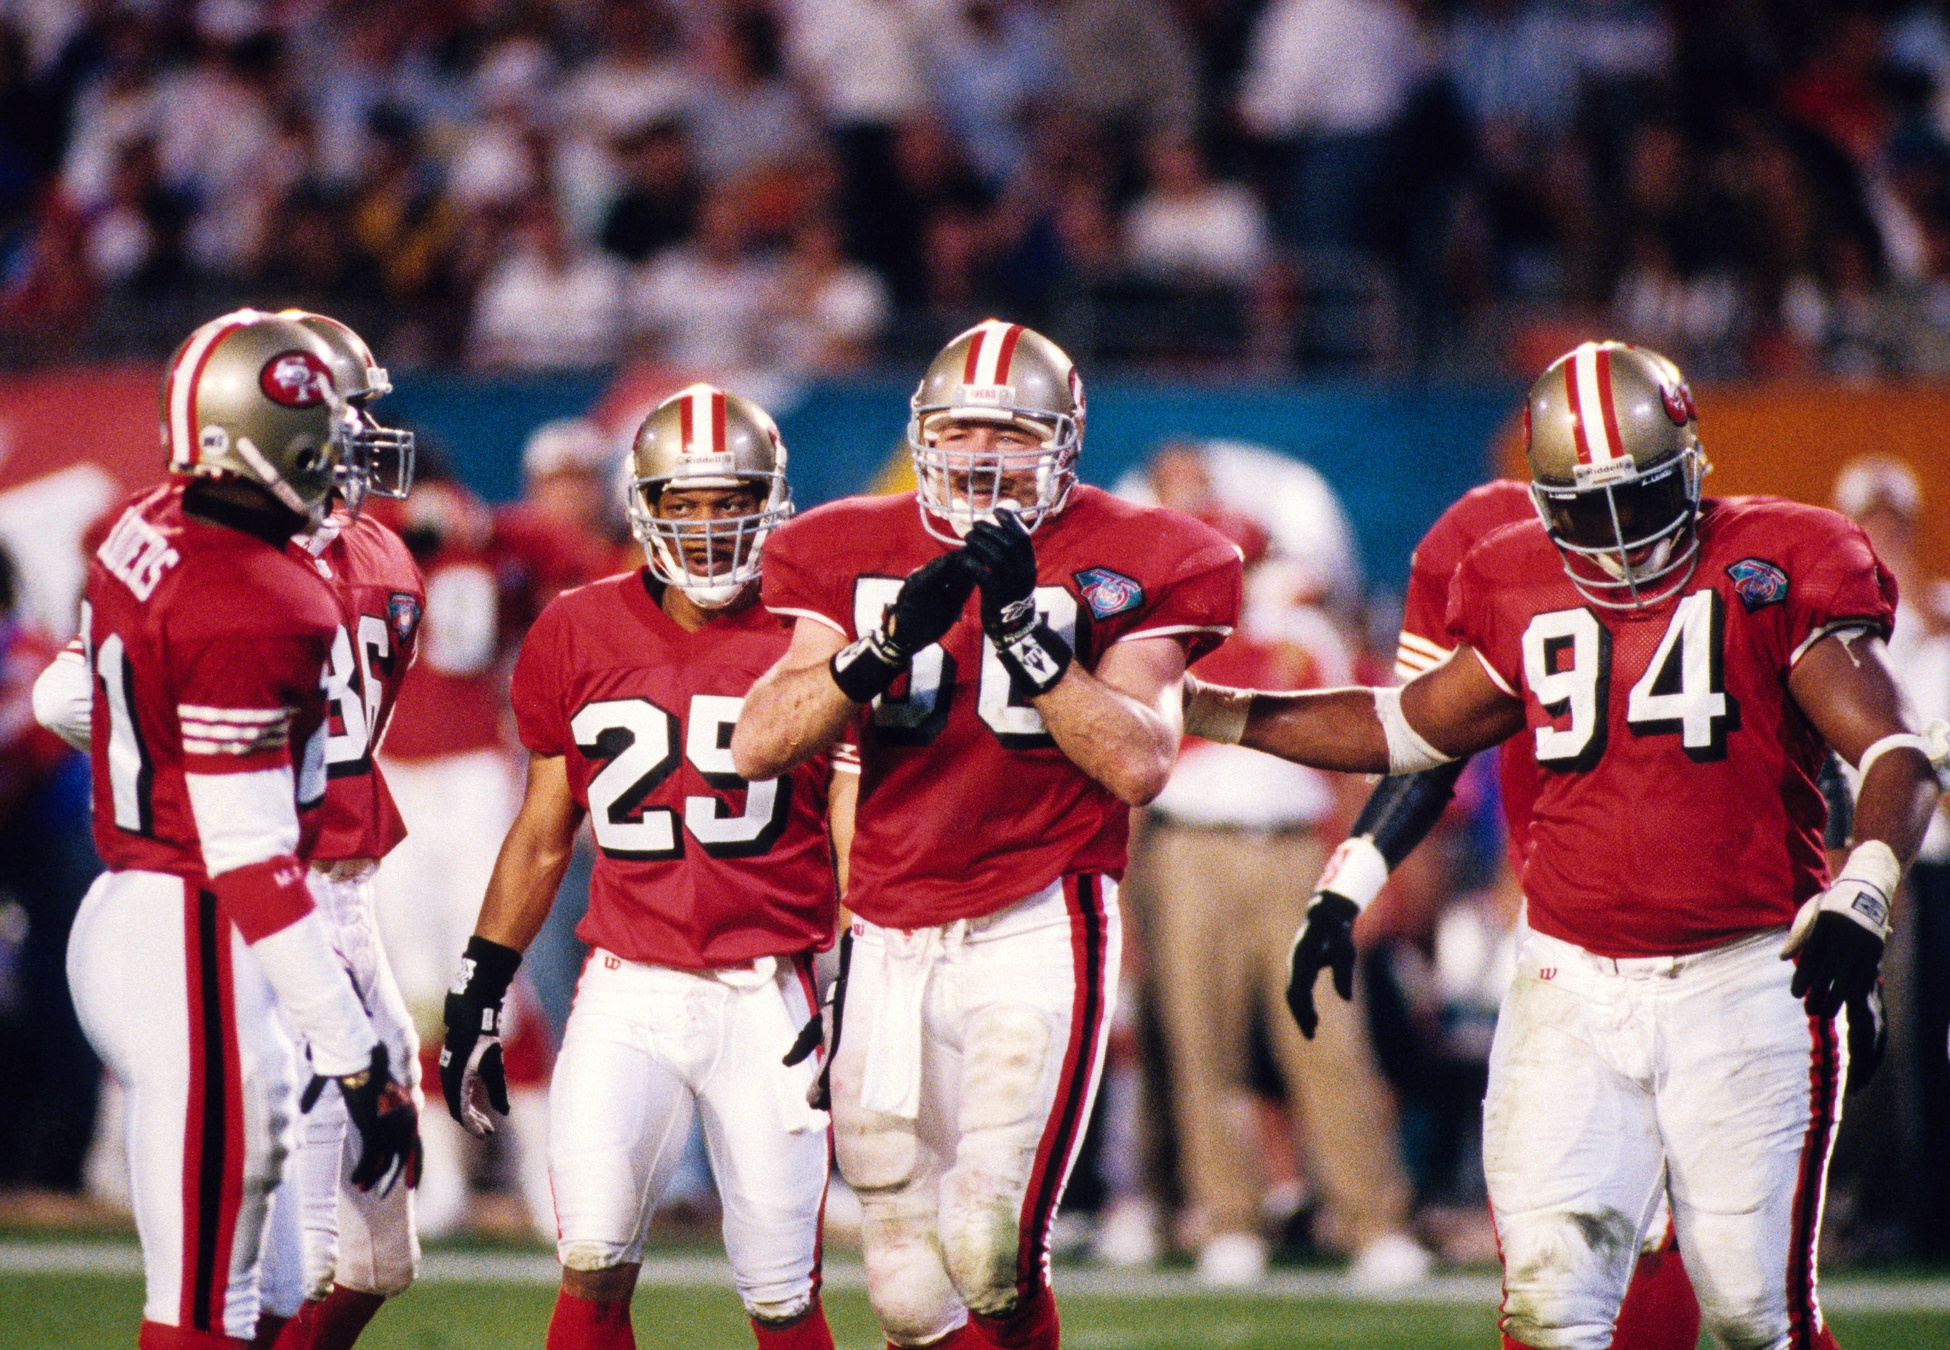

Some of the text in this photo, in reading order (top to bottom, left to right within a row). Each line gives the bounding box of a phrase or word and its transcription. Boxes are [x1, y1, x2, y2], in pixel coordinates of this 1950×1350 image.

[1585, 462, 1623, 476] Riddell
[1521, 588, 1740, 774] 94
[569, 694, 793, 860] 25
